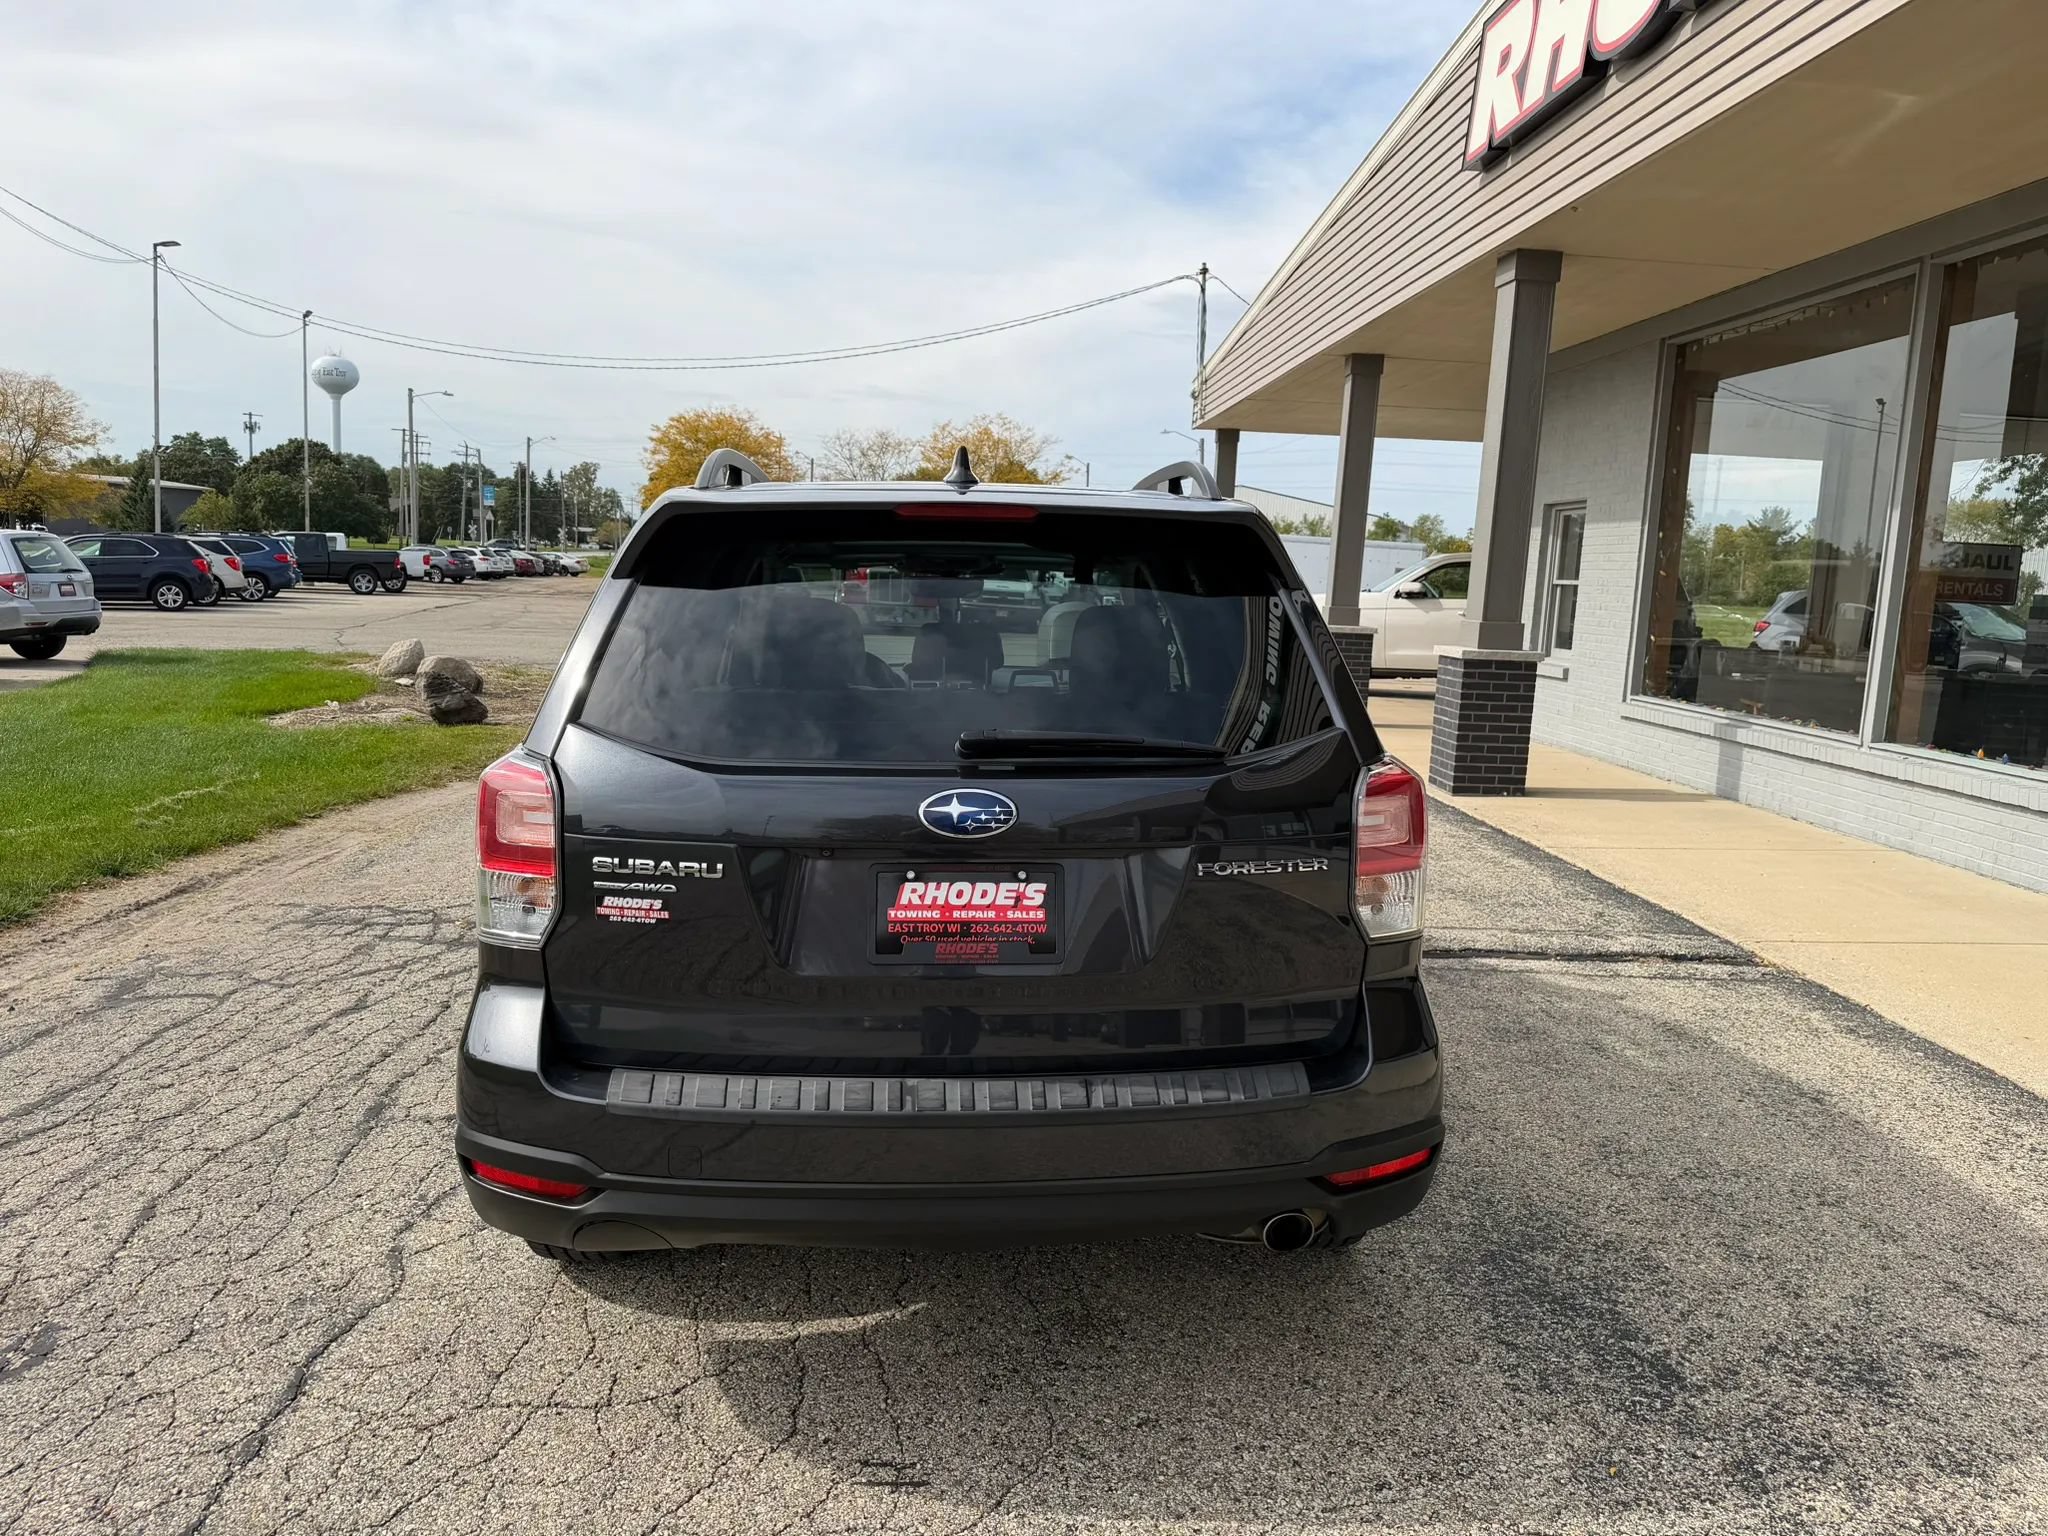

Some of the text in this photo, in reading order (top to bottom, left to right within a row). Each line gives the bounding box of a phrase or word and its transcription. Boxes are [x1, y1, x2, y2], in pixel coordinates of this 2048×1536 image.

[592, 856, 723, 879] SUBARU
[1197, 857, 1329, 876] FORESTER
[624, 883, 677, 893] AWD
[899, 881, 1048, 906] RHODE'S
[602, 896, 663, 910] RHODE'S
[596, 906, 669, 919] TOWING REPAIR SALES
[888, 909, 1045, 919] TOWING REPAIR SALES
[888, 923, 1048, 933] EAST TROY WI 262-642-4TOW
[900, 935, 922, 944] Over
[935, 943, 999, 954] RHODE'S
